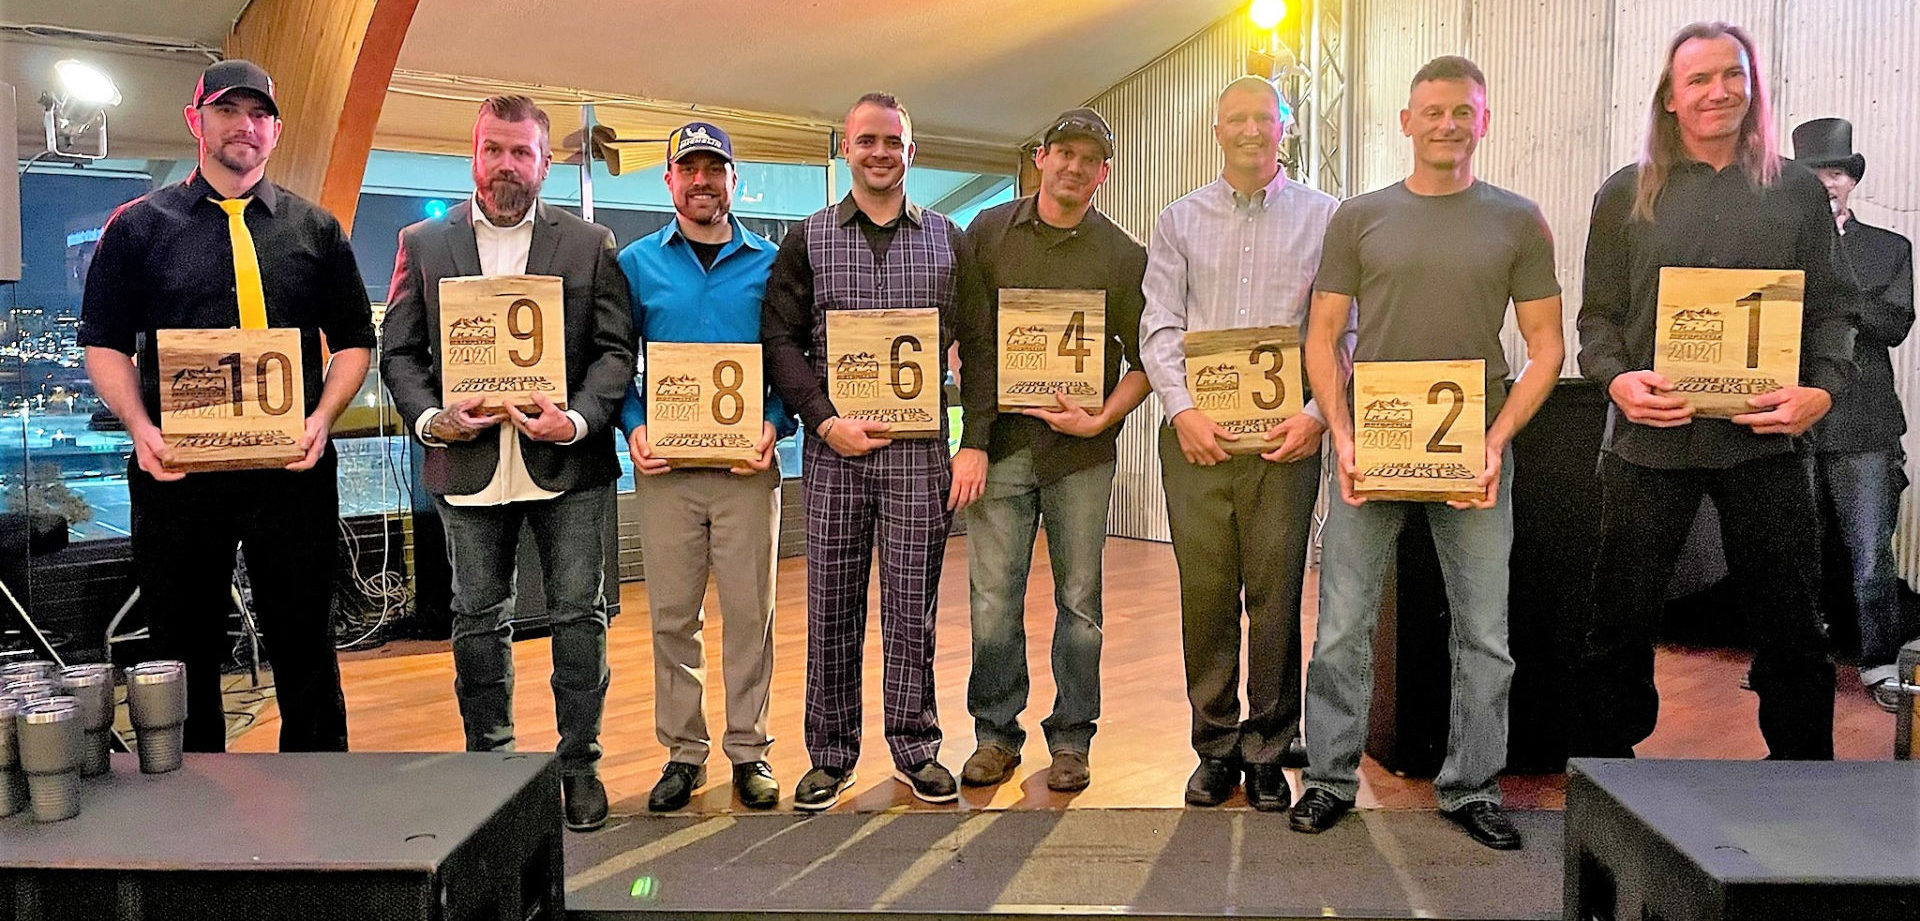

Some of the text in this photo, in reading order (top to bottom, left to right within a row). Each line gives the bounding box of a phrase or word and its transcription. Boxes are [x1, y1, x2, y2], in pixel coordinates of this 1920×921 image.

[507, 298, 543, 367] 9
[1736, 292, 1762, 368] 1
[1058, 311, 1091, 373] 4
[449, 346, 496, 364] 2021
[1006, 353, 1046, 370] 2021
[1668, 341, 1722, 363] 2021
[890, 335, 923, 400] 6
[1249, 344, 1285, 410] 3
[218, 352, 293, 416] 10
[451, 381, 555, 392] ROCKIES
[711, 360, 744, 425] 8
[837, 380, 879, 398] 2021
[171, 401, 226, 418] 2021
[1197, 391, 1240, 410] 2021
[655, 403, 699, 421] 2021
[1426, 381, 1464, 453] 2
[656, 438, 754, 448] ROCKIES
[1363, 430, 1412, 449] 2021
[1364, 467, 1475, 479] ROCKIES
